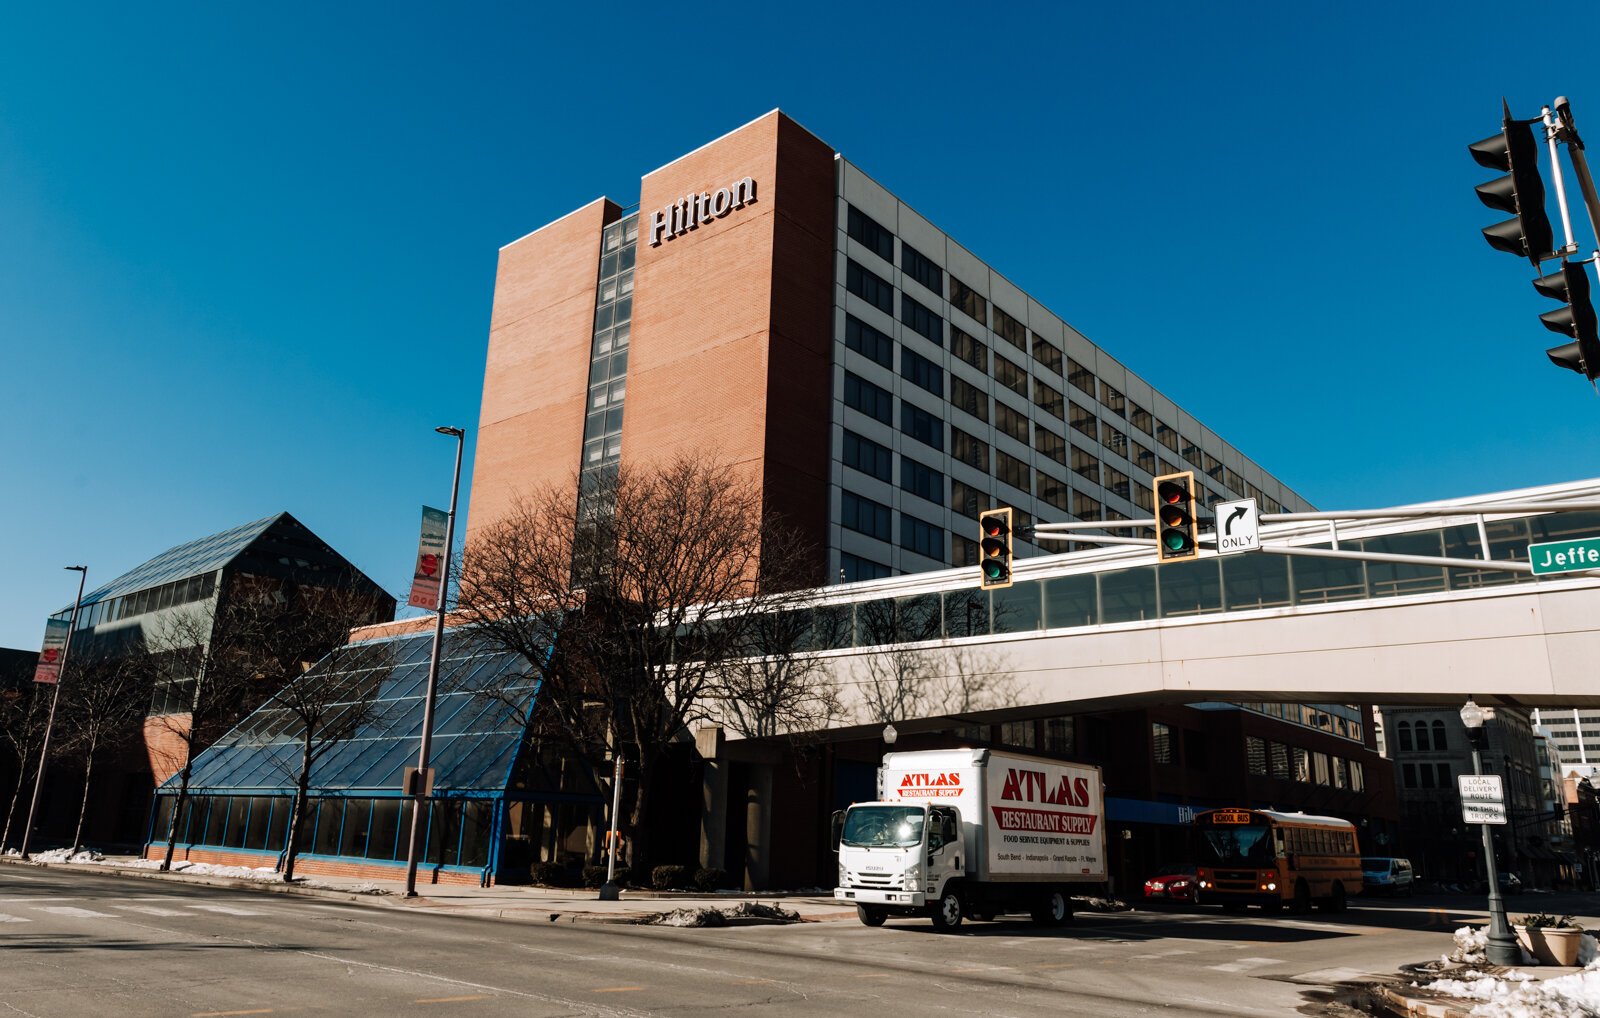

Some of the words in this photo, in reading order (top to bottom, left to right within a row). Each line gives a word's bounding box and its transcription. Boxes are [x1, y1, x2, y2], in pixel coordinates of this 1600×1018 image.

[648, 176, 756, 247] Hilton
[1222, 535, 1253, 548] ONLY
[1540, 546, 1600, 567] Jeffe
[901, 773, 960, 786] ATLAS
[902, 789, 936, 797] RESTAURANT
[938, 788, 959, 797] SUPPLY
[1001, 768, 1090, 807] ATLAS
[1002, 811, 1059, 830] RESTAURANT
[1062, 815, 1091, 833] SUPPLY
[1214, 814, 1235, 822] SCHOOL
[1237, 814, 1248, 822] BUS
[1003, 835, 1018, 843] FOOD
[1019, 835, 1039, 844] SERVICE
[1040, 837, 1065, 845] EQUIPMENT
[1071, 838, 1090, 846] SUPPLIES
[1010, 853, 1021, 861] Bend
[1025, 854, 1049, 862] Indianapolis
[1053, 854, 1064, 862] Grand
[1065, 855, 1077, 863] Rapids
[1086, 855, 1096, 863] Wayne
